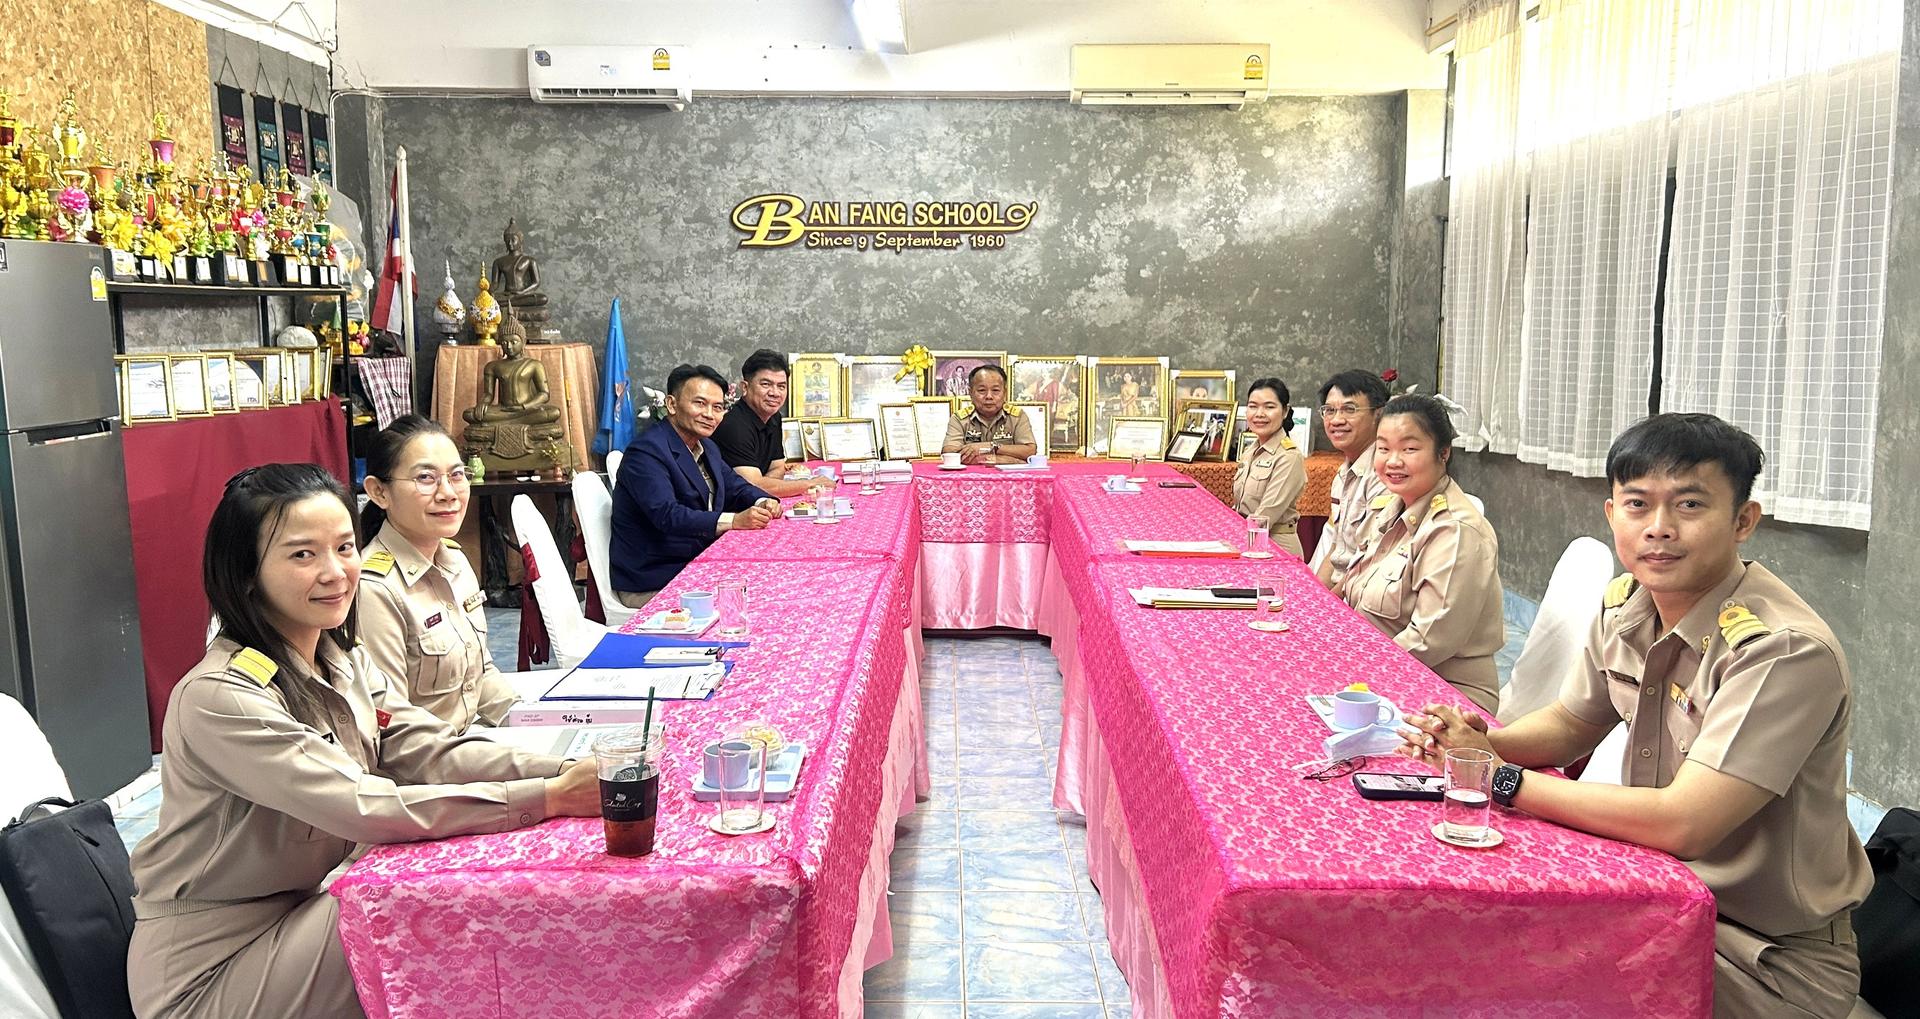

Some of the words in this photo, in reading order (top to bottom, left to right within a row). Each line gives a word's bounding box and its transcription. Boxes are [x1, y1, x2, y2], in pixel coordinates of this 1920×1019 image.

[732, 193, 841, 246] BAN
[849, 202, 907, 225] FANG
[914, 202, 1005, 226] SCHOOL
[807, 231, 853, 248] Since
[858, 236, 868, 249] 9
[874, 230, 961, 252] September
[970, 234, 1005, 248] 1960
